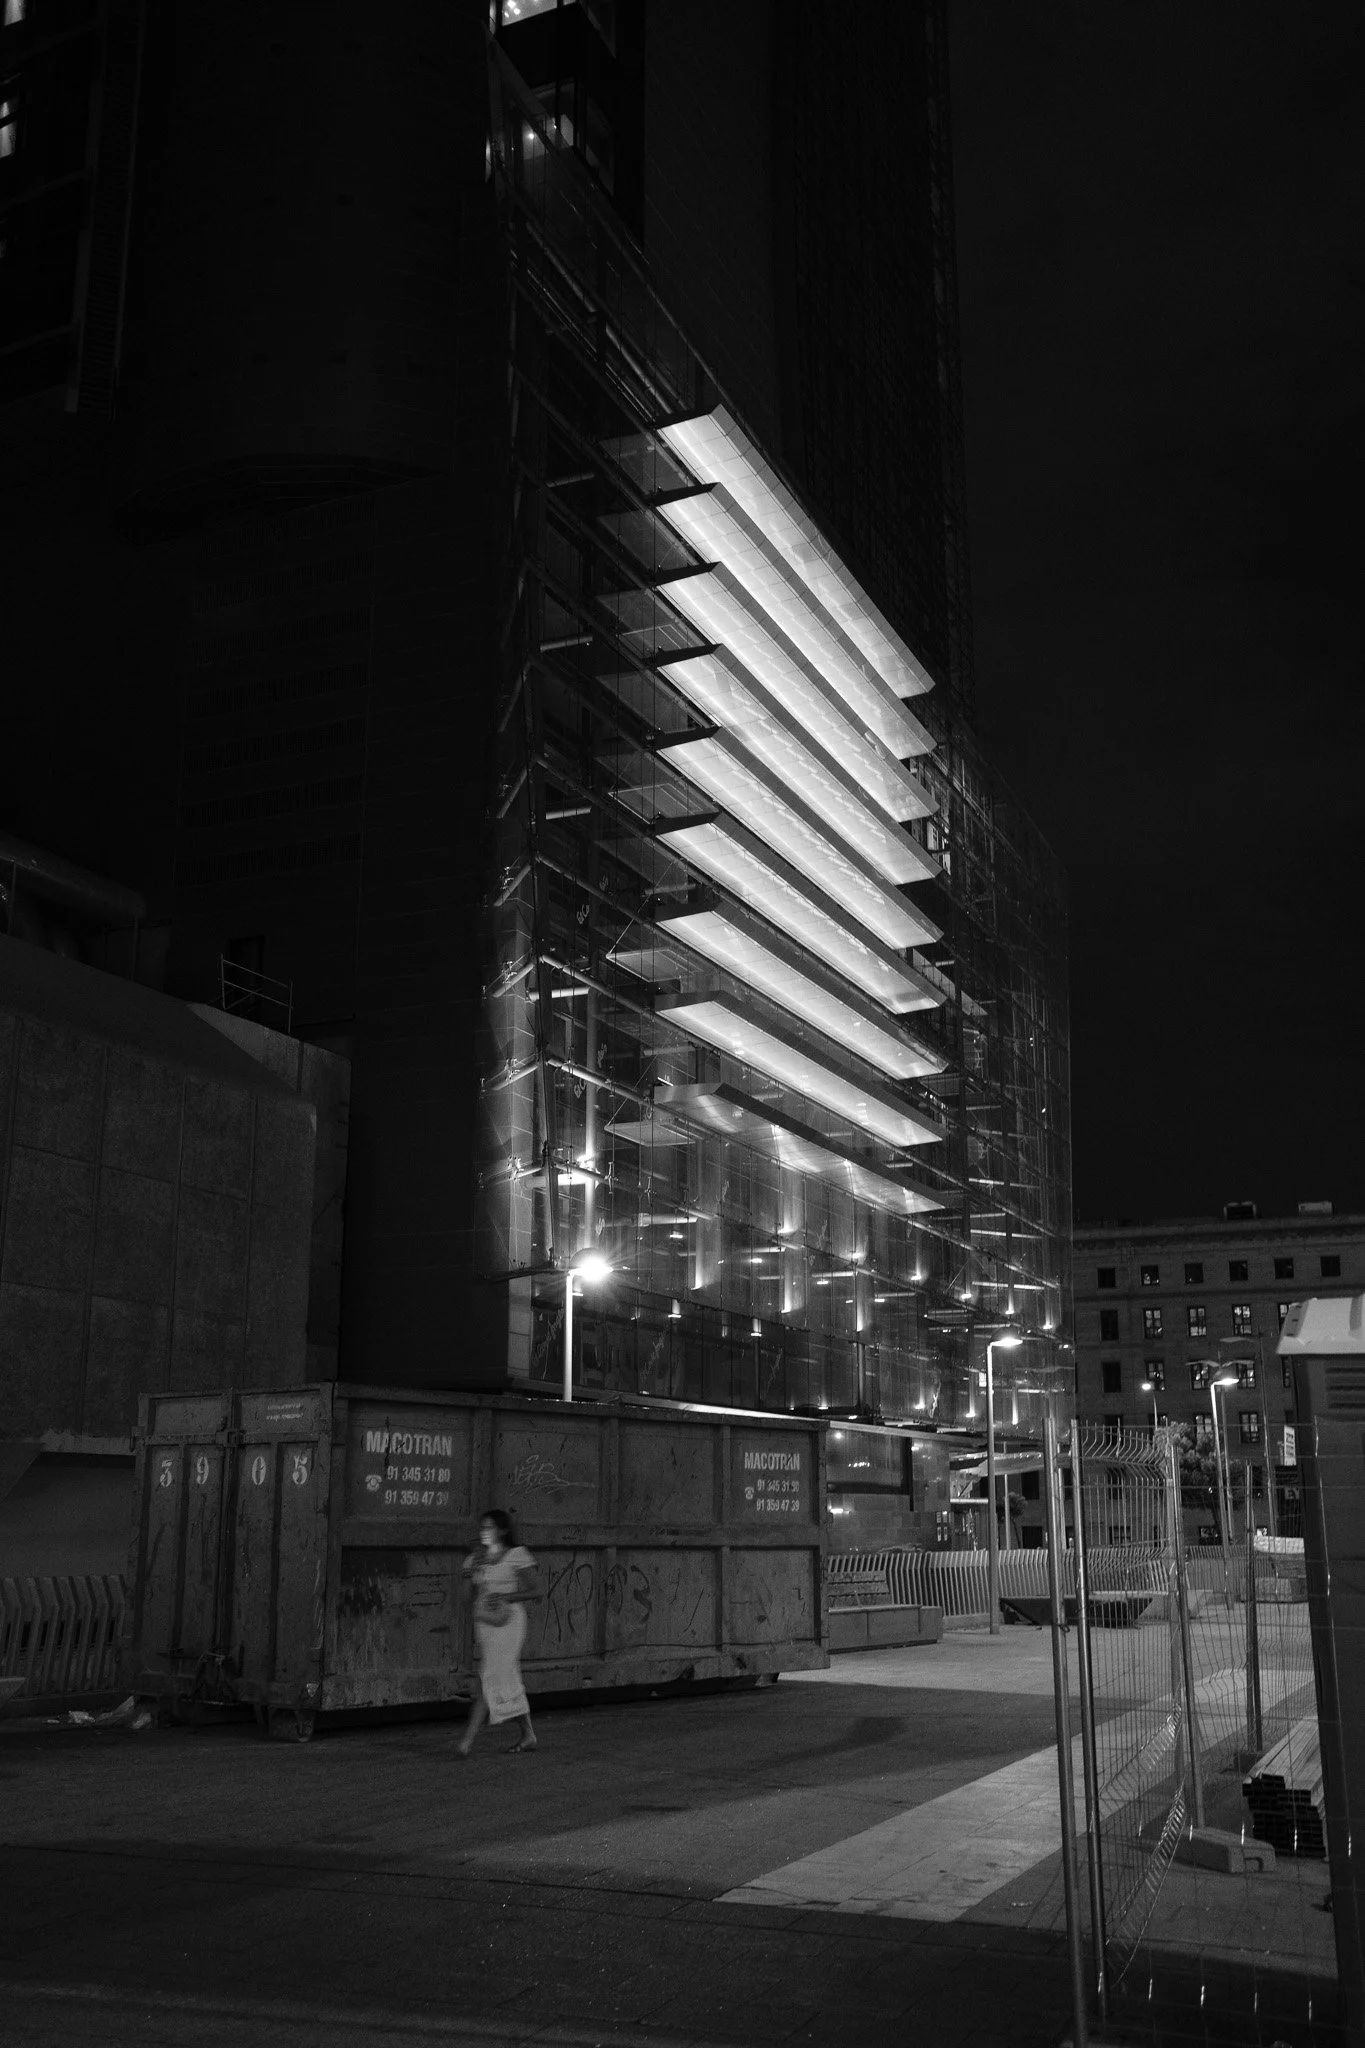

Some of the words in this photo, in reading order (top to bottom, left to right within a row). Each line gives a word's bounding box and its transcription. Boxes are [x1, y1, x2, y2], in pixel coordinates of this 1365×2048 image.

[366, 1430, 453, 1457] MACOTRAN
[744, 1451, 800, 1471] MACOTRAN
[196, 1455, 209, 1485] 9
[387, 1465, 399, 1481] 91
[402, 1467, 421, 1482] 345
[424, 1466, 436, 1482] 31
[757, 1479, 765, 1491] 91
[385, 1489, 398, 1505] 91
[421, 1490, 435, 1506] 47
[780, 1499, 790, 1512] 47
